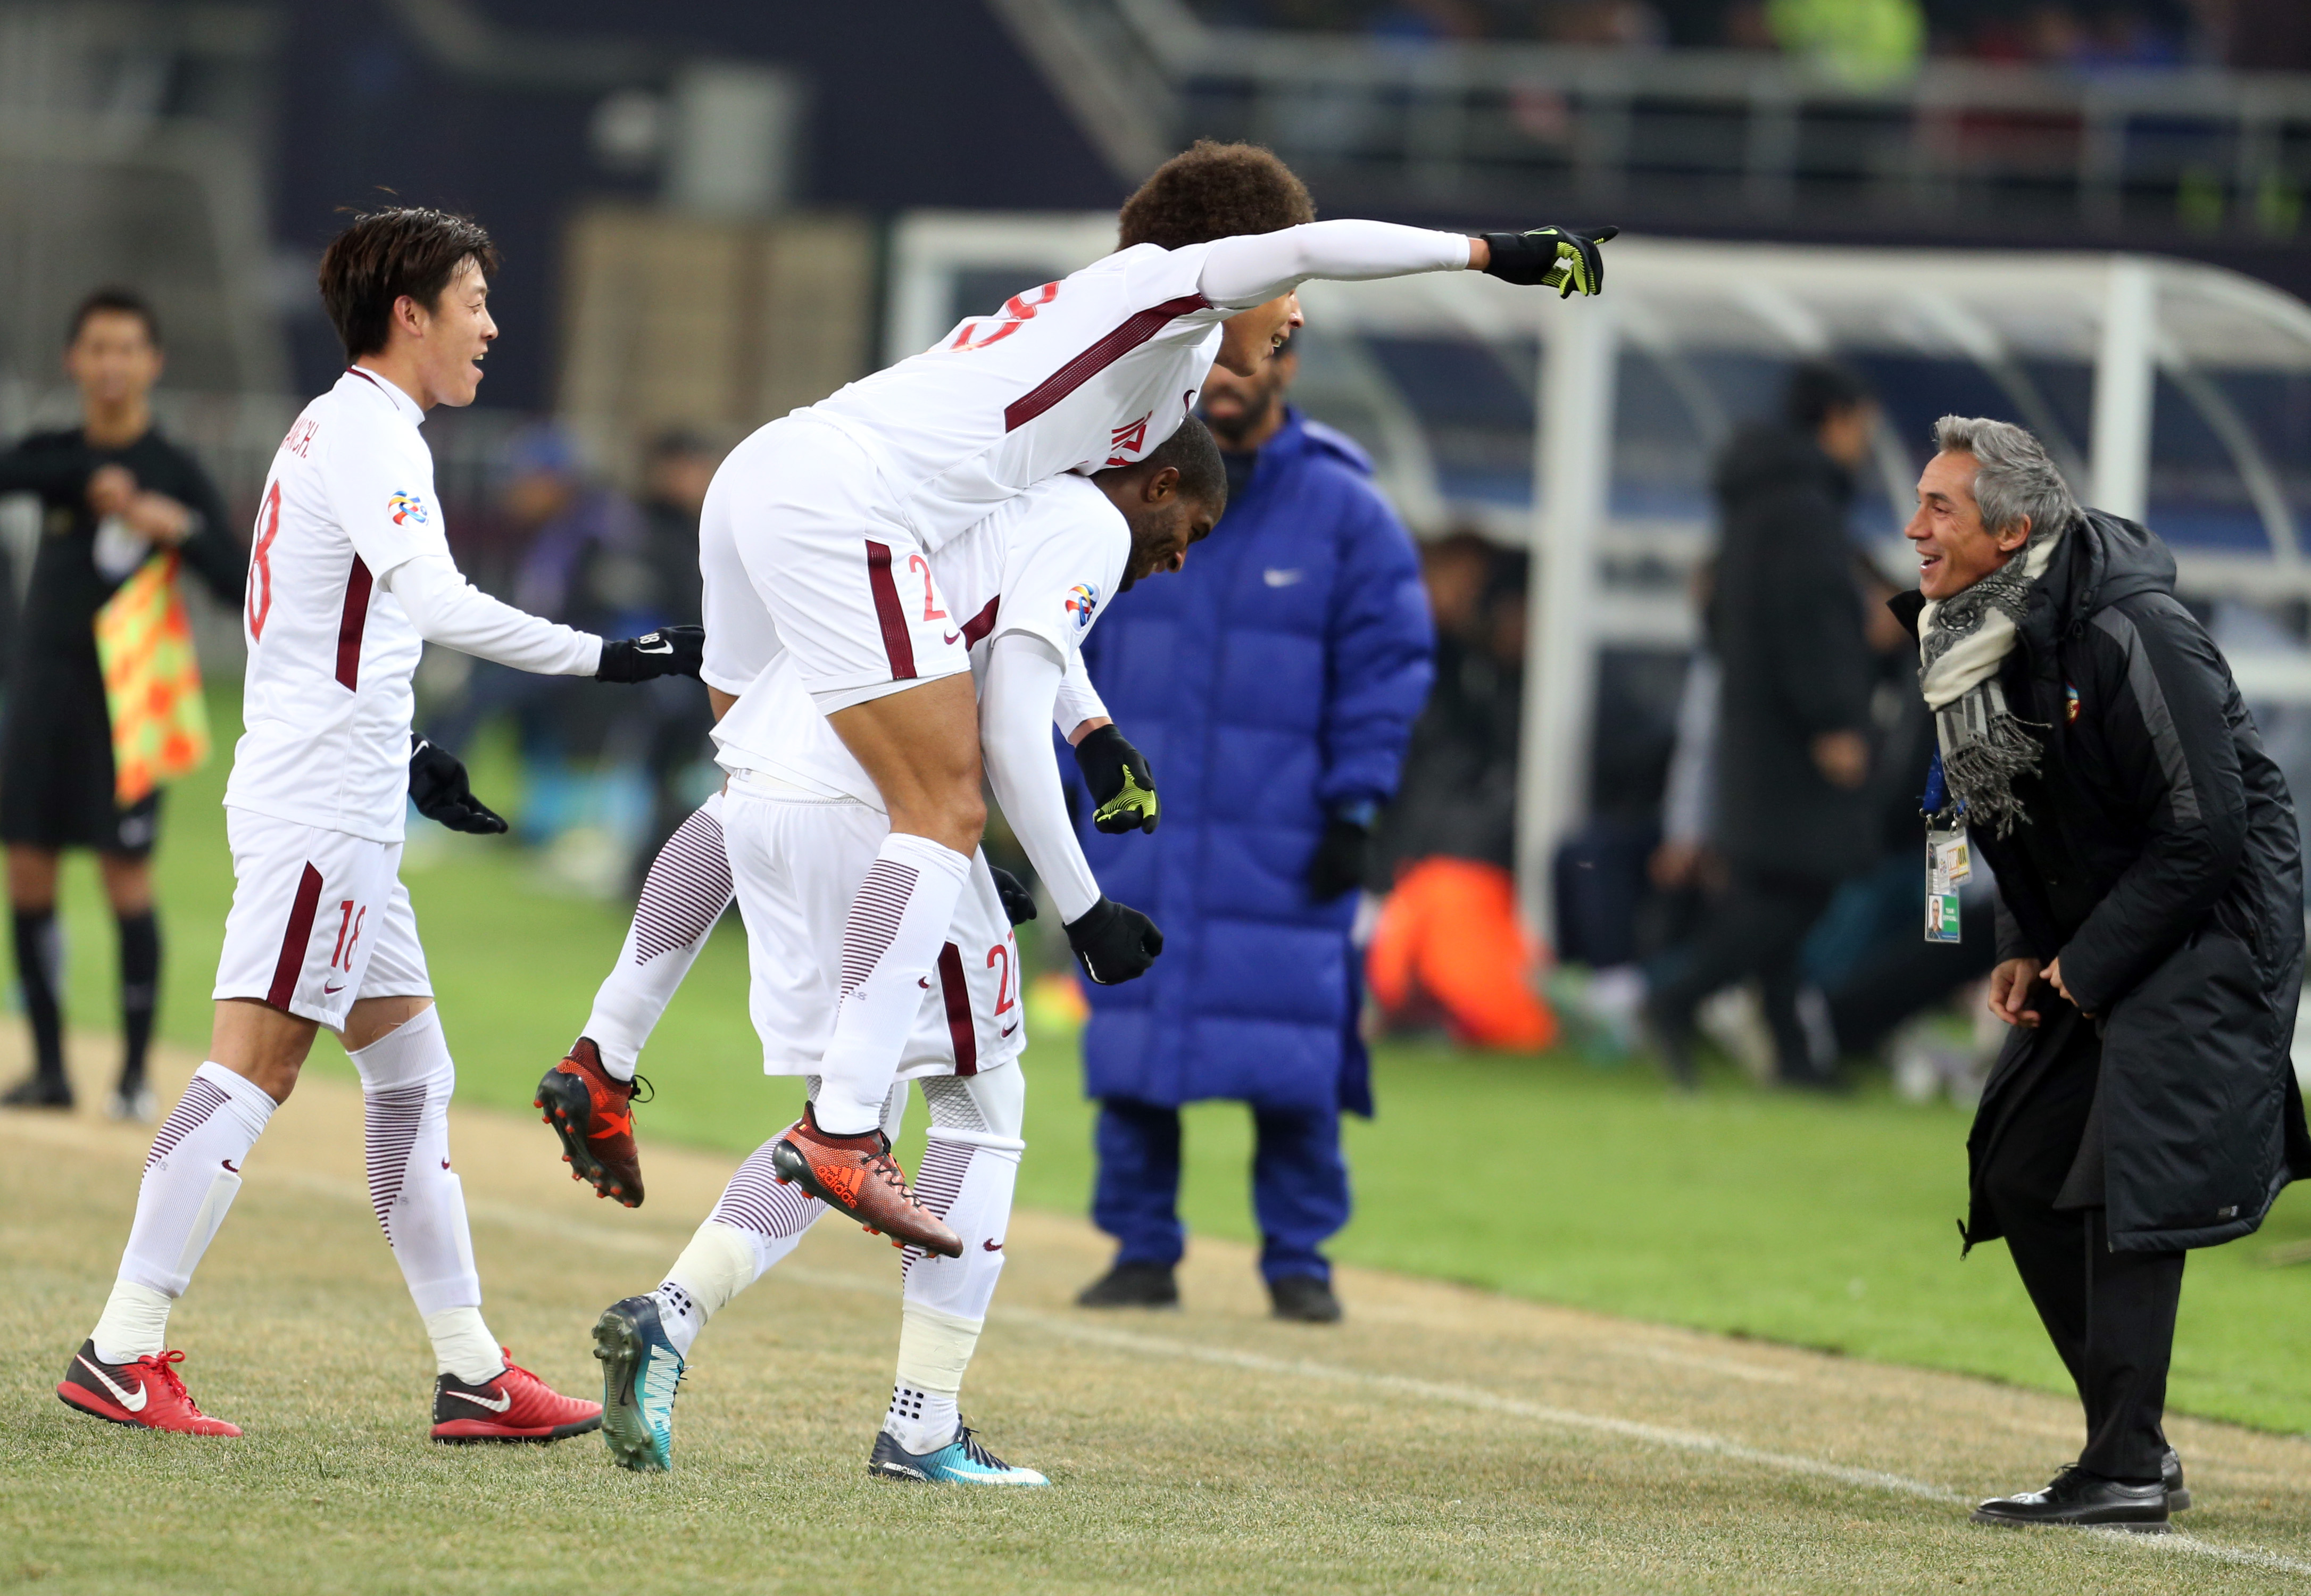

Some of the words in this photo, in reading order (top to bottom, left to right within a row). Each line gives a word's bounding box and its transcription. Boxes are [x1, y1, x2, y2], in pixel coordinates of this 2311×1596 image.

[909, 554, 947, 622] 2
[639, 632, 660, 644] 18
[331, 900, 366, 974] 18
[817, 1165, 858, 1209] adidas
